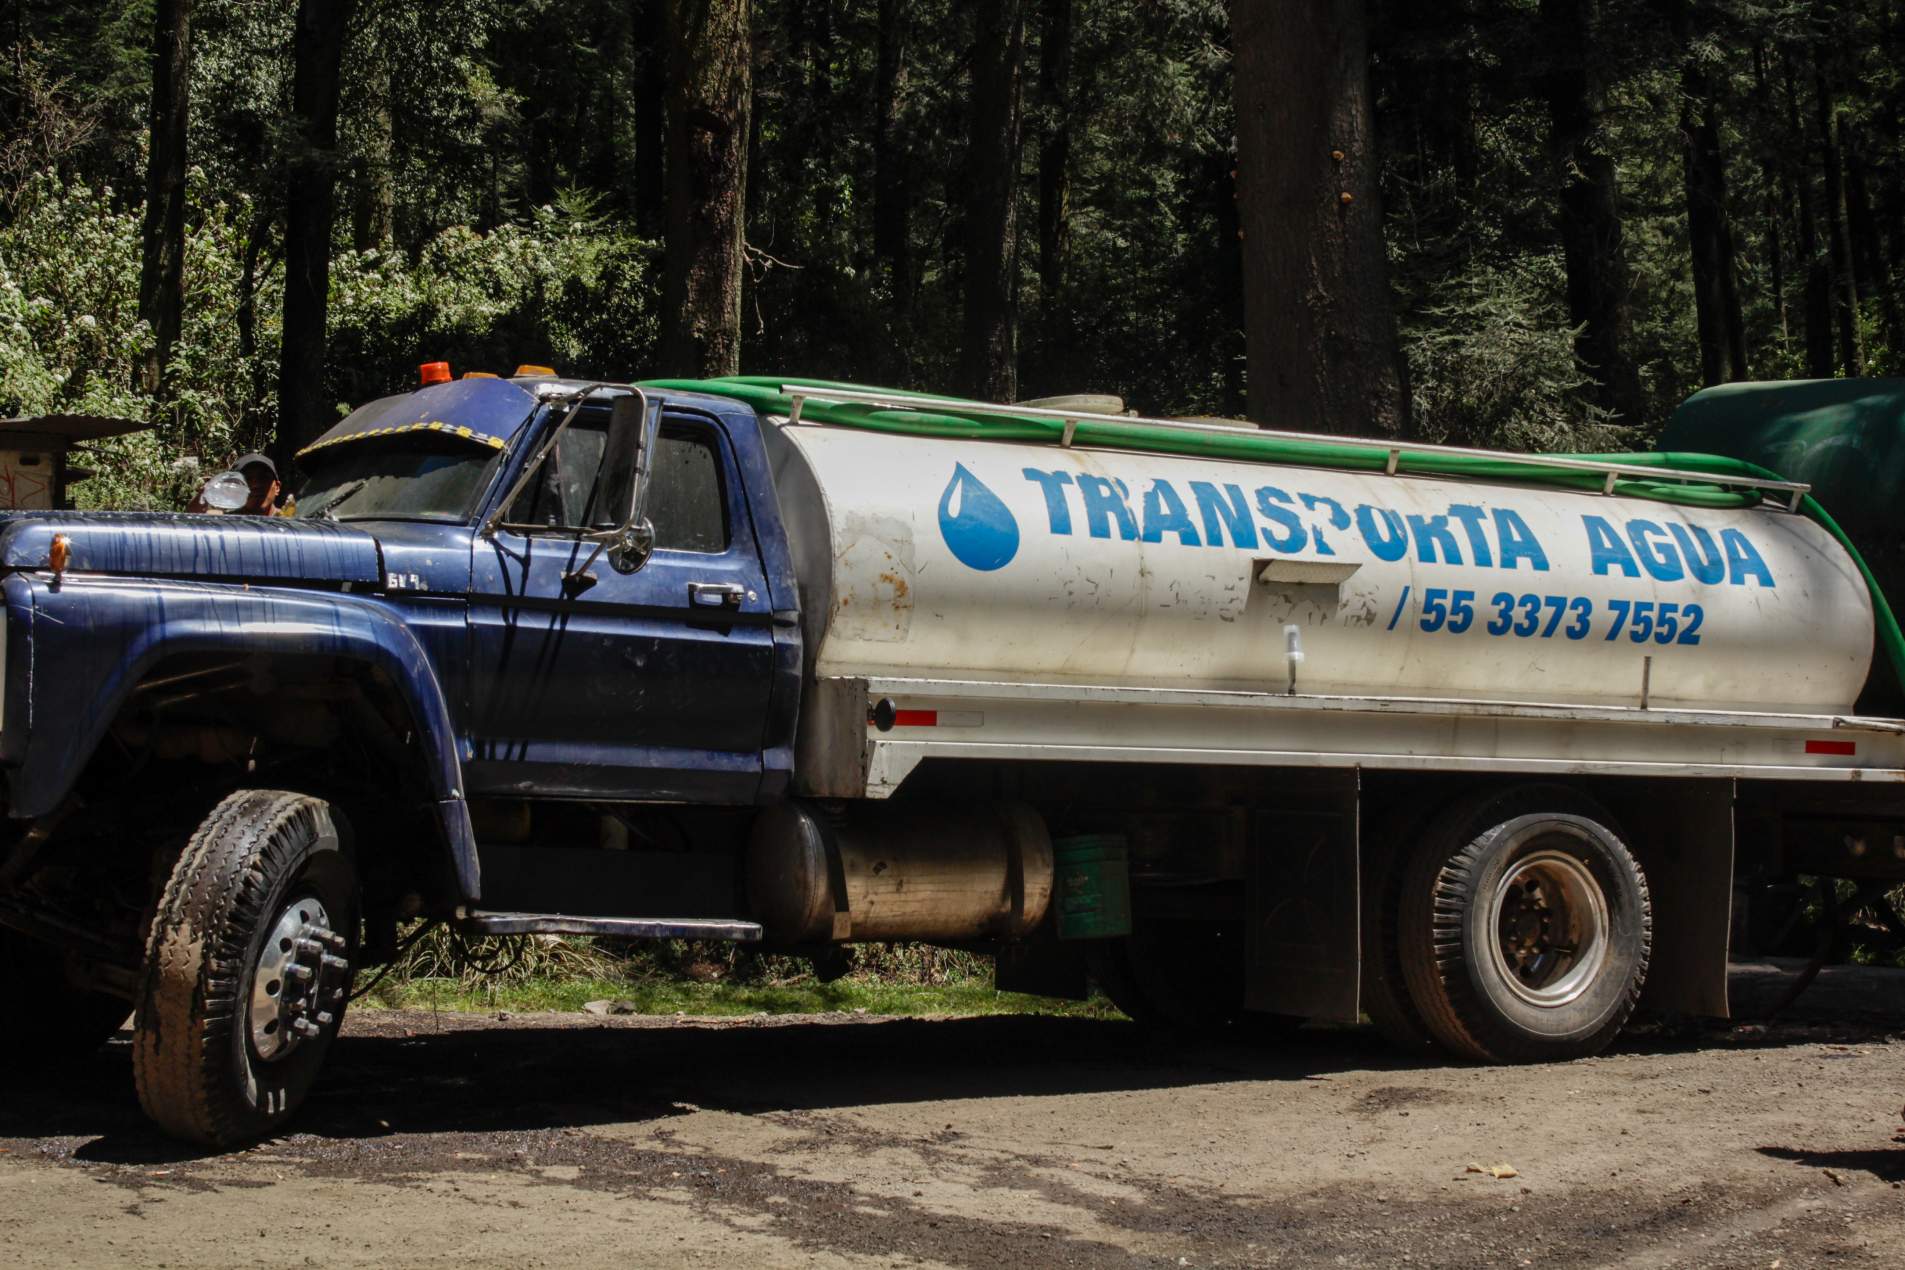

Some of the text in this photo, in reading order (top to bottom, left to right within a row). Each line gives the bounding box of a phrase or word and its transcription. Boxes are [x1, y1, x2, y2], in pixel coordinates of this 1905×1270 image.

[1022, 467, 1776, 588] TRANSPORTA AGUA
[1419, 588, 1476, 634] 55
[1486, 591, 1594, 641] 3373
[1604, 599, 1705, 645] 7552
